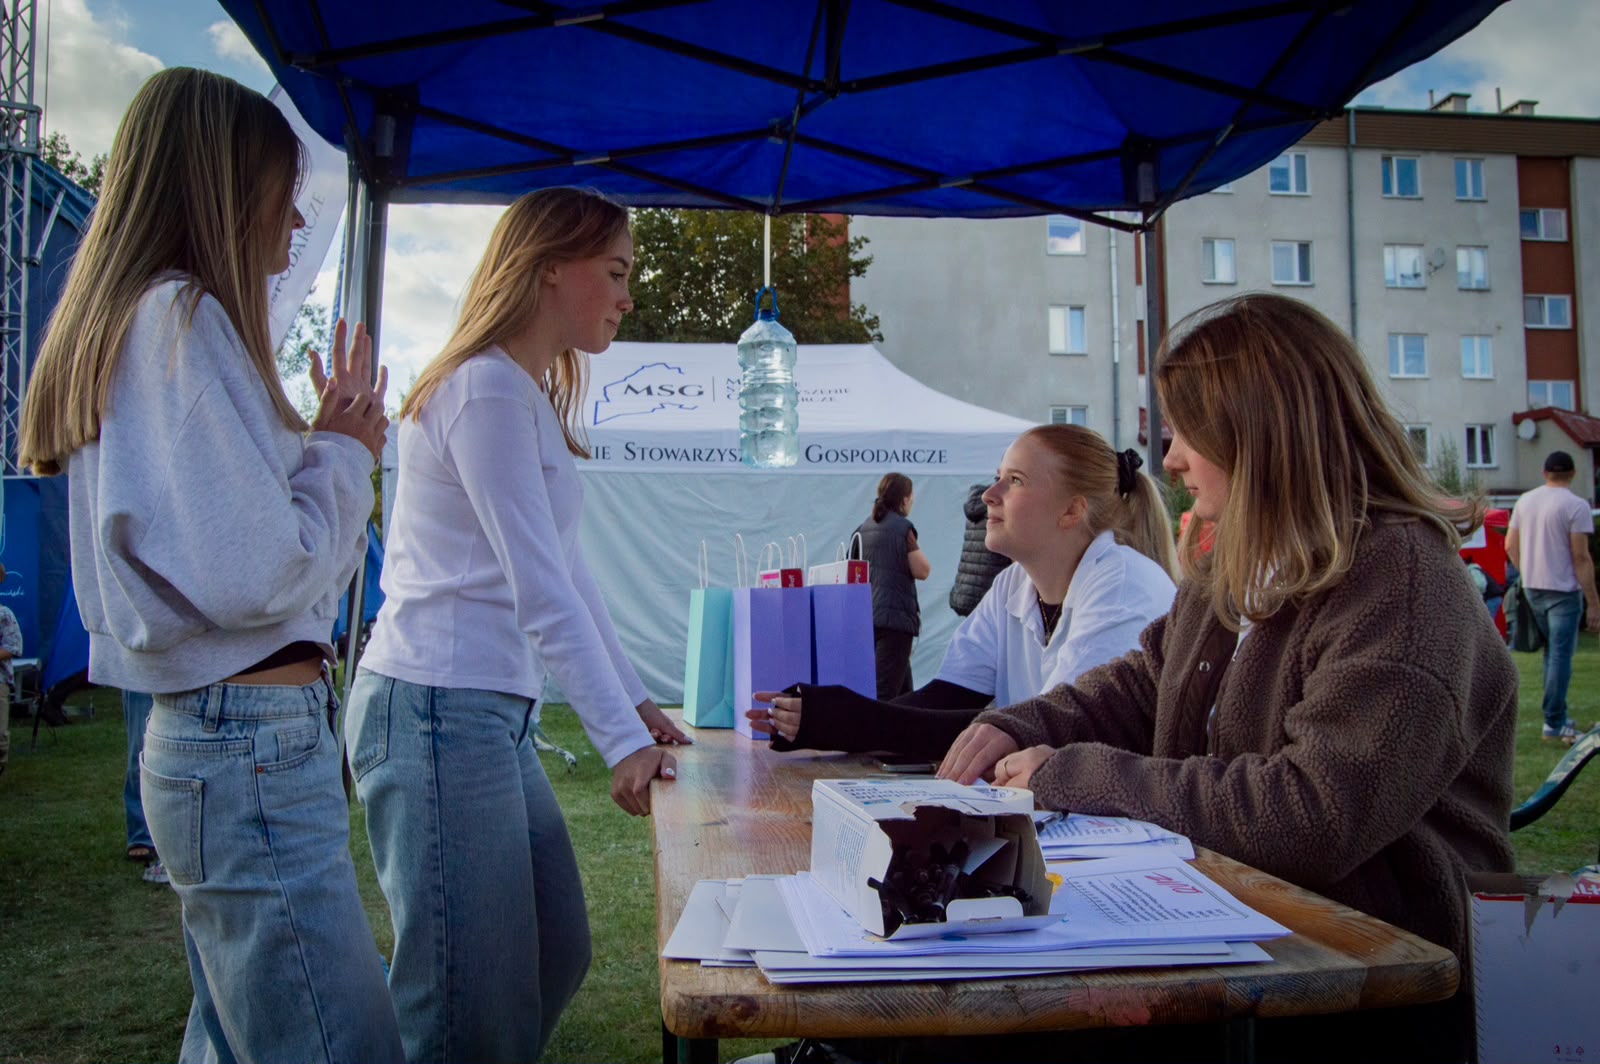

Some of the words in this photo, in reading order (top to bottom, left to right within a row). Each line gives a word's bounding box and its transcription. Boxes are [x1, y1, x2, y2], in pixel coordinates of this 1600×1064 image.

[623, 383, 705, 397] MSG
[624, 441, 744, 463] STOWARZYS
[804, 443, 949, 464] GOSPODARCZE
